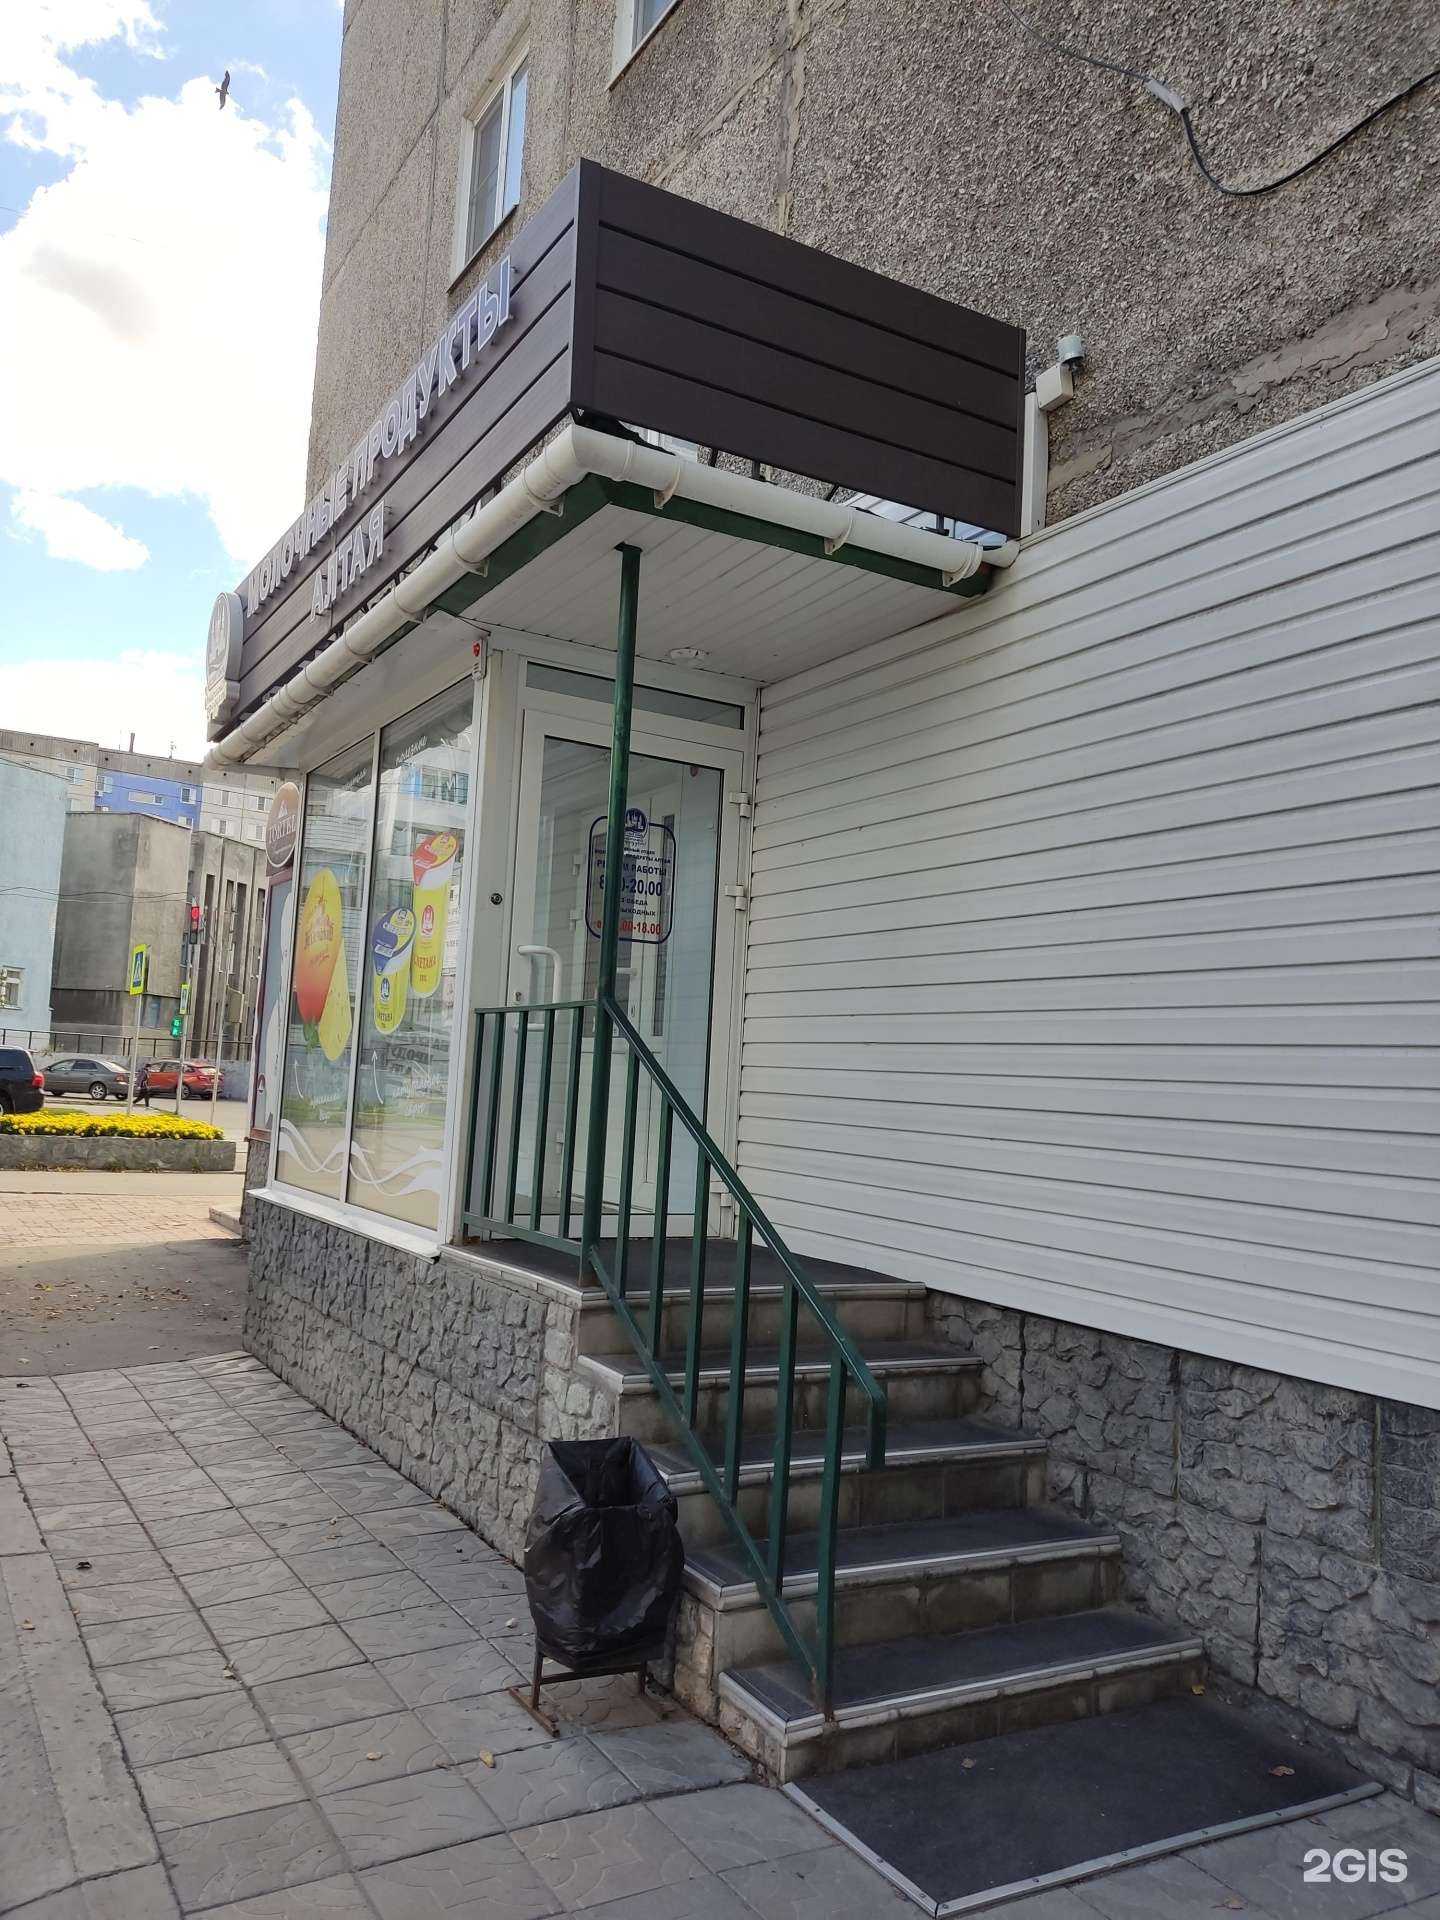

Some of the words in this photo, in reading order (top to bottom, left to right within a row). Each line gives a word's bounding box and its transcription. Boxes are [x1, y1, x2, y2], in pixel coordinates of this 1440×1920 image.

[246, 460, 350, 619] МОЛОЧНЫЕ
[351, 254, 512, 501] ПРОДУКТЫ
[309, 499, 385, 623] АЛТАЯ
[631, 863, 667, 876] РАБОТЫ
[621, 908, 656, 917] ЫХОДНЫХ
